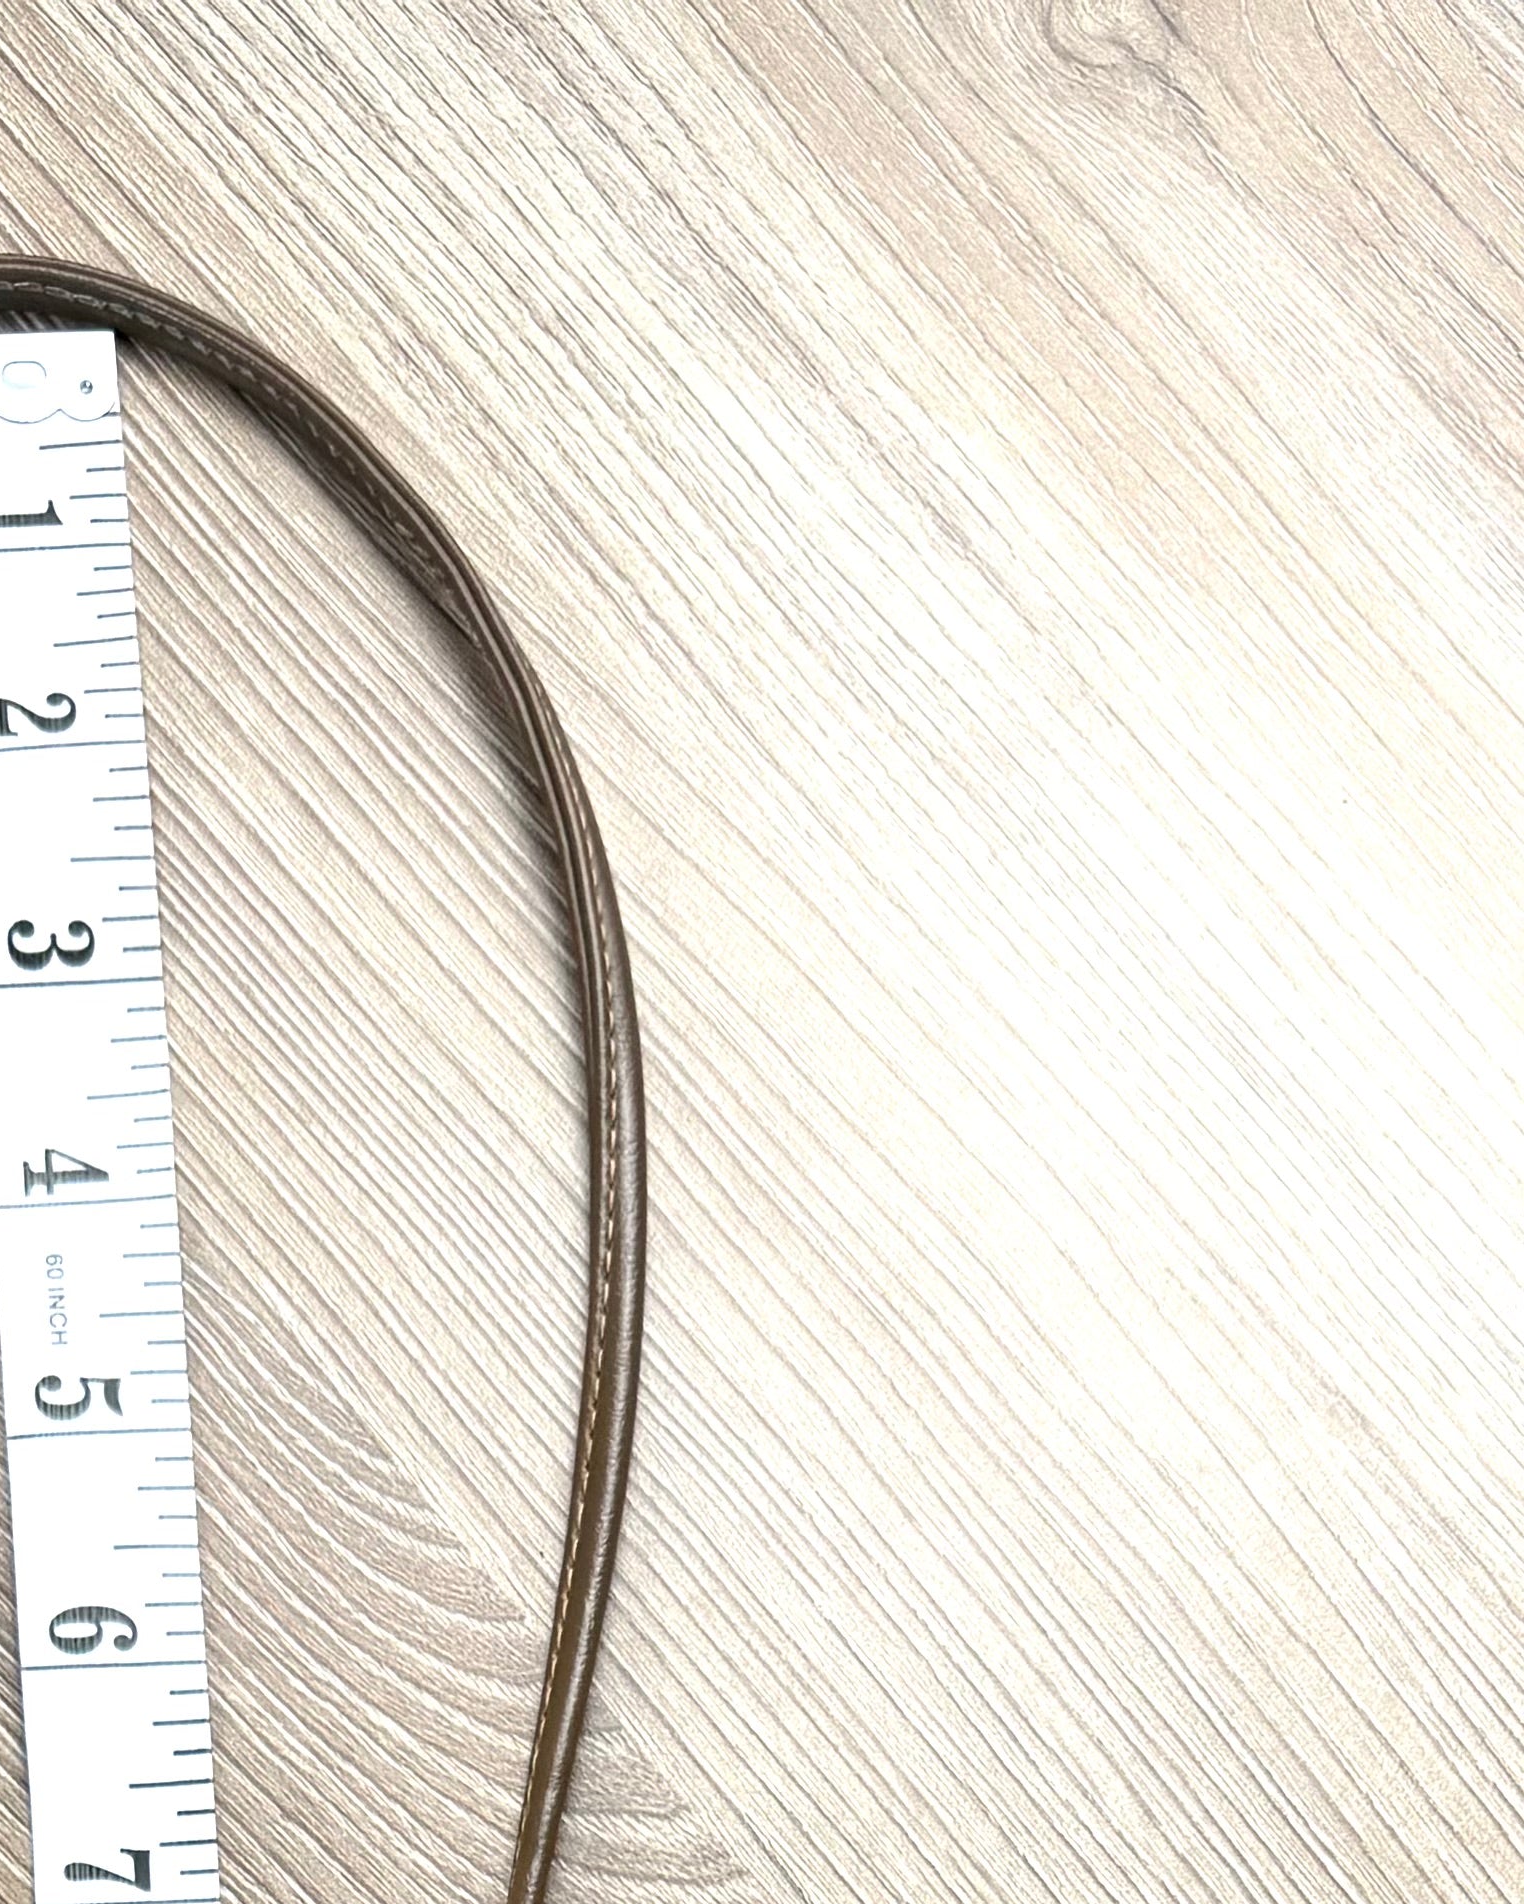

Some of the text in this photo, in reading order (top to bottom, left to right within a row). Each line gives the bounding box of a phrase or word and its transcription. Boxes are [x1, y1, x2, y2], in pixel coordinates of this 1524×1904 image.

[7, 919, 95, 971] 3
[23, 1148, 109, 1197] 4
[46, 1254, 68, 1346] 60 INCH
[34, 1375, 123, 1420] 5
[48, 1605, 138, 1655] 6
[63, 1848, 151, 1892] 7
